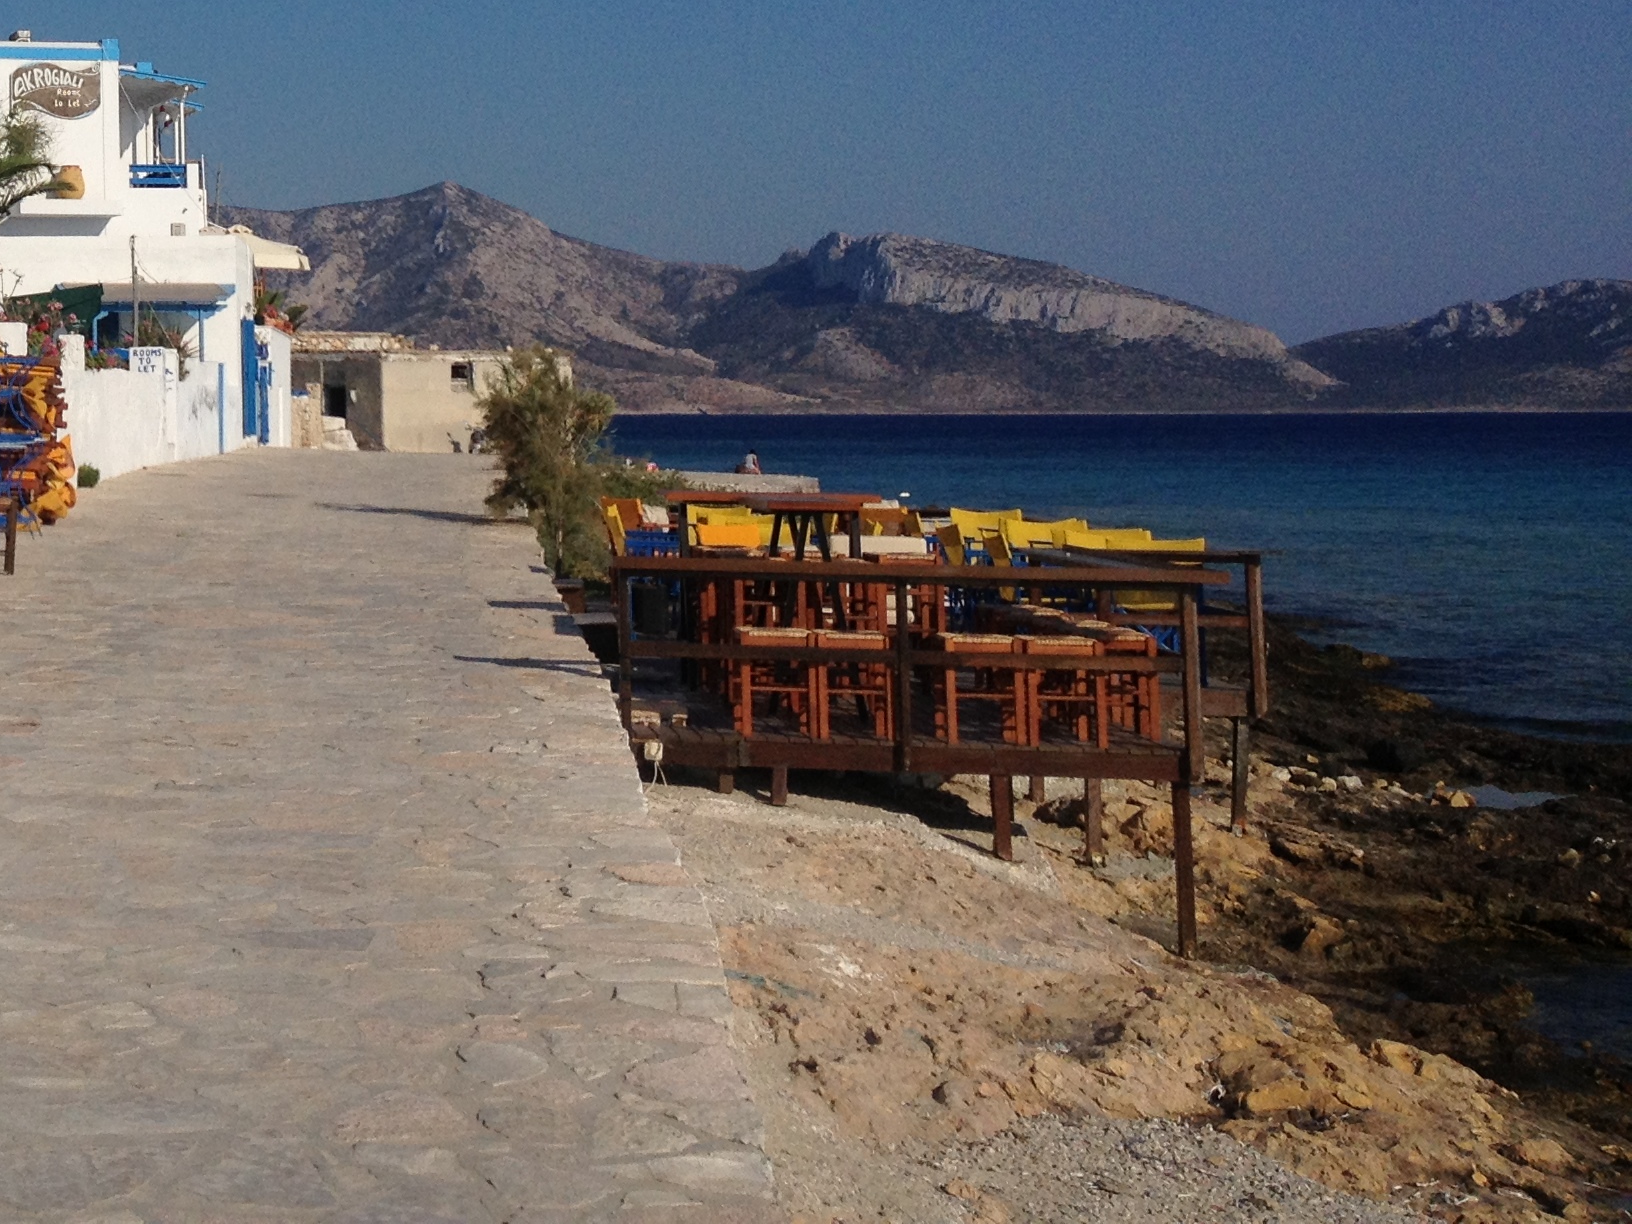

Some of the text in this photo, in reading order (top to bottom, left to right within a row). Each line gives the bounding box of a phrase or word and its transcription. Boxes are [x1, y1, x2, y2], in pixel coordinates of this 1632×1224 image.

[14, 67, 85, 97] AKROGIALI
[133, 349, 162, 357] ROOMS
[138, 357, 151, 365] TO
[138, 364, 156, 373] LET
